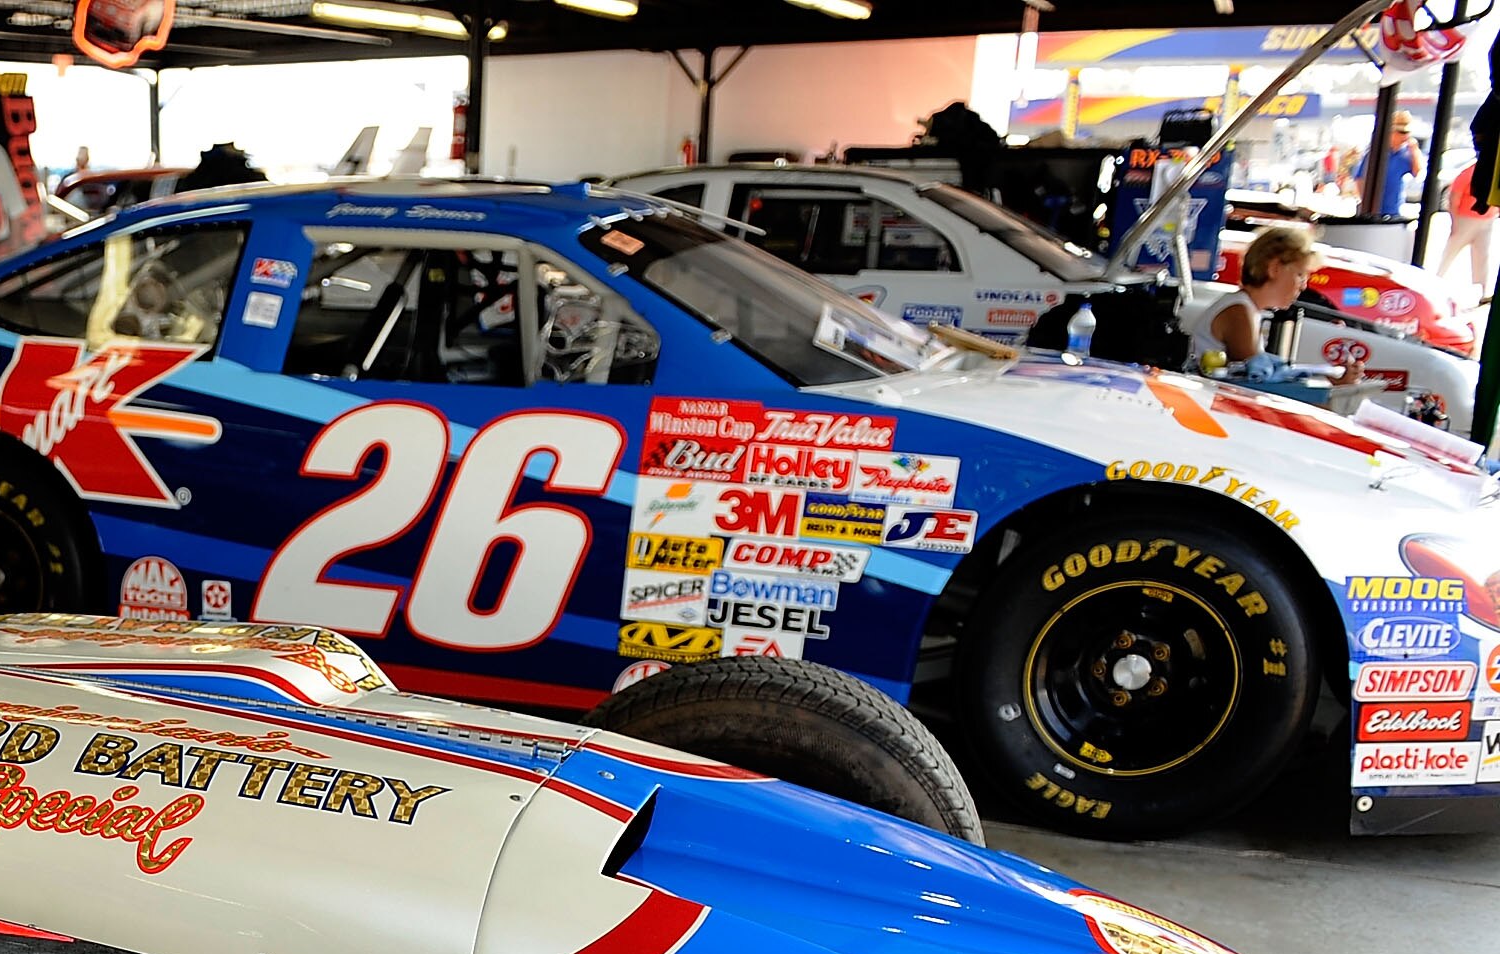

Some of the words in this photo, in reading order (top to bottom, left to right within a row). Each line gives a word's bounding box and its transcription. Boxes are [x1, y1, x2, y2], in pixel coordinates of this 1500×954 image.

[678, 401, 729, 416] NASCAR
[650, 412, 716, 436] Winston
[718, 416, 756, 442] Cup
[664, 439, 746, 472] Bud
[750, 447, 851, 490] Holley
[252, 398, 627, 653] 26
[715, 489, 800, 537] 3M
[886, 511, 973, 542] JE
[657, 540, 708, 556] Auto
[733, 543, 832, 568] COMP
[630, 578, 704, 603] SPICER
[710, 571, 838, 607] Bowman
[1348, 577, 1464, 600] MOOG
[709, 601, 826, 636] JESEL
[1362, 617, 1452, 650] CLEVITE
[1364, 669, 1466, 694] SIMPSON
[1366, 709, 1461, 734] Edelbrock
[1360, 747, 1469, 772] plasti-kote
[74, 732, 451, 825] BATTERY
[1025, 771, 1113, 820] EAGLE
